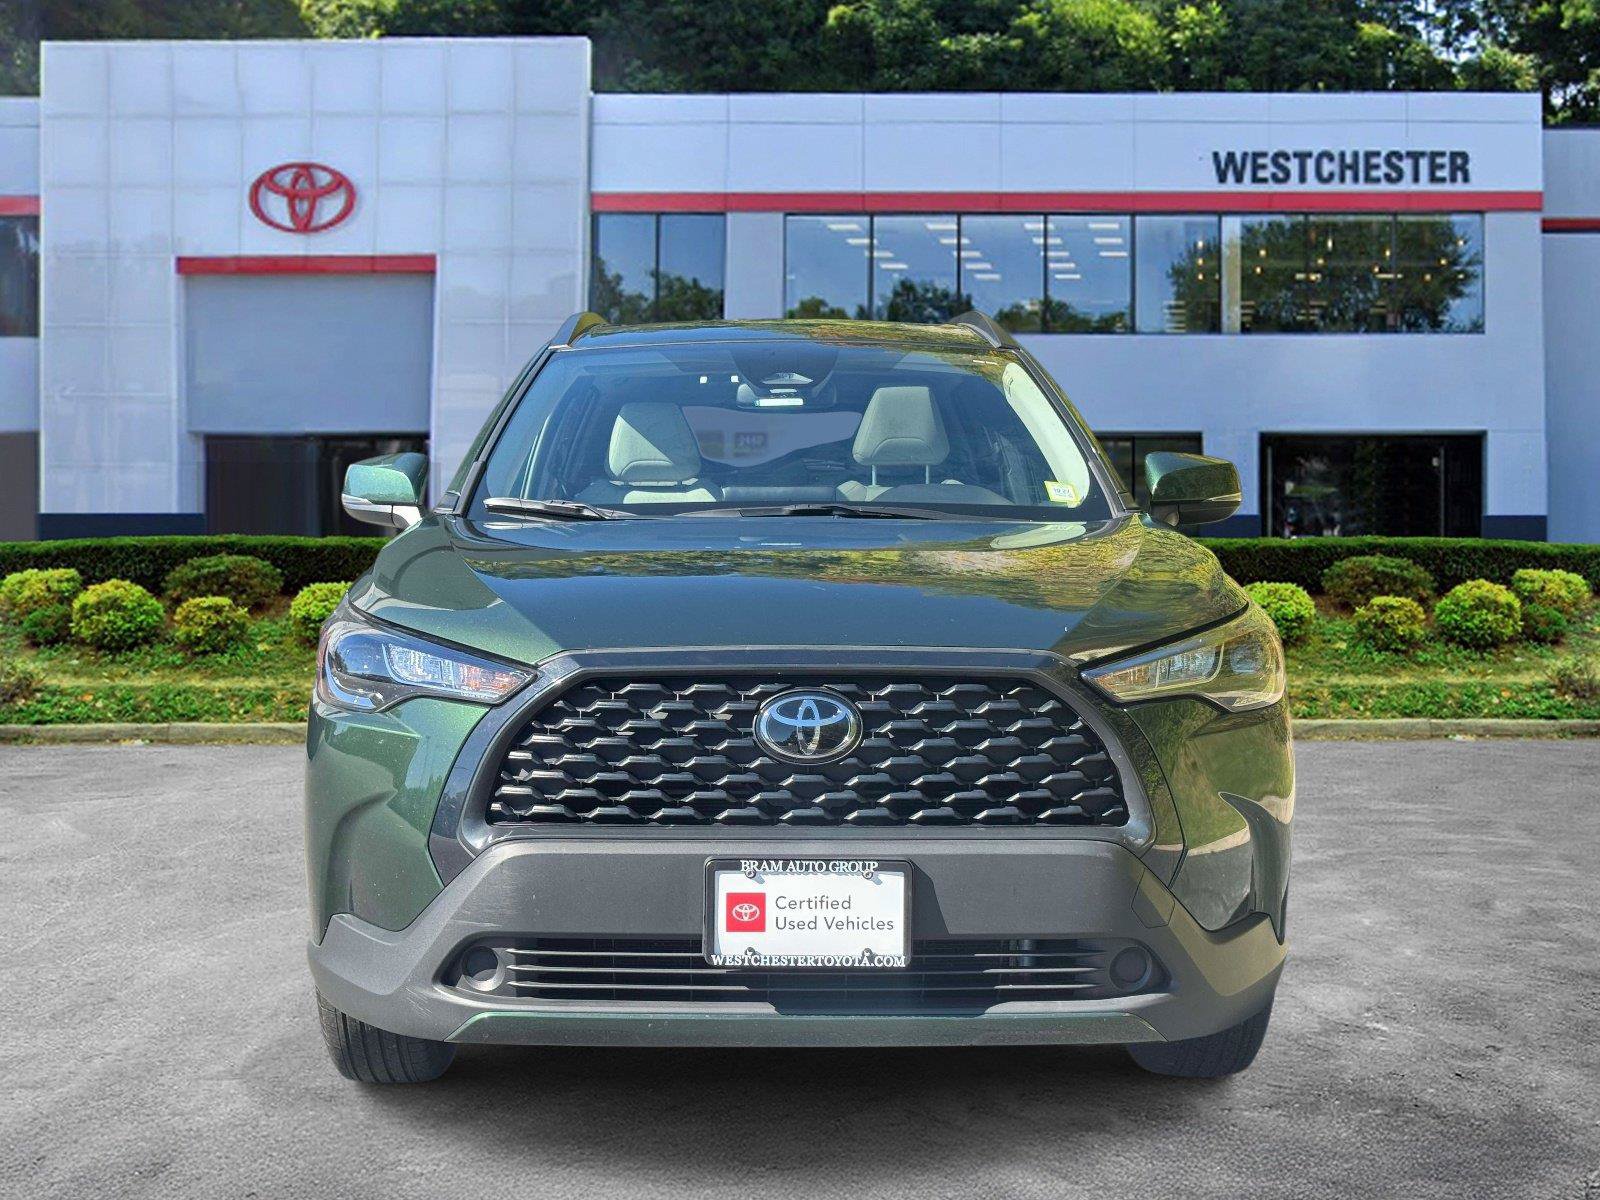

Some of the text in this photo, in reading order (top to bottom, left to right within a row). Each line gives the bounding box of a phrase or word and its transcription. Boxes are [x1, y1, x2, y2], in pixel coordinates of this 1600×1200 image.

[1212, 150, 1471, 184] WESTCHESTER
[740, 860, 879, 873] BRAM AUTO GROUP
[775, 895, 852, 910] Certified
[775, 916, 895, 931] Used Vehicles
[711, 954, 906, 968] WESTCHESTERTOYOTA.COM
